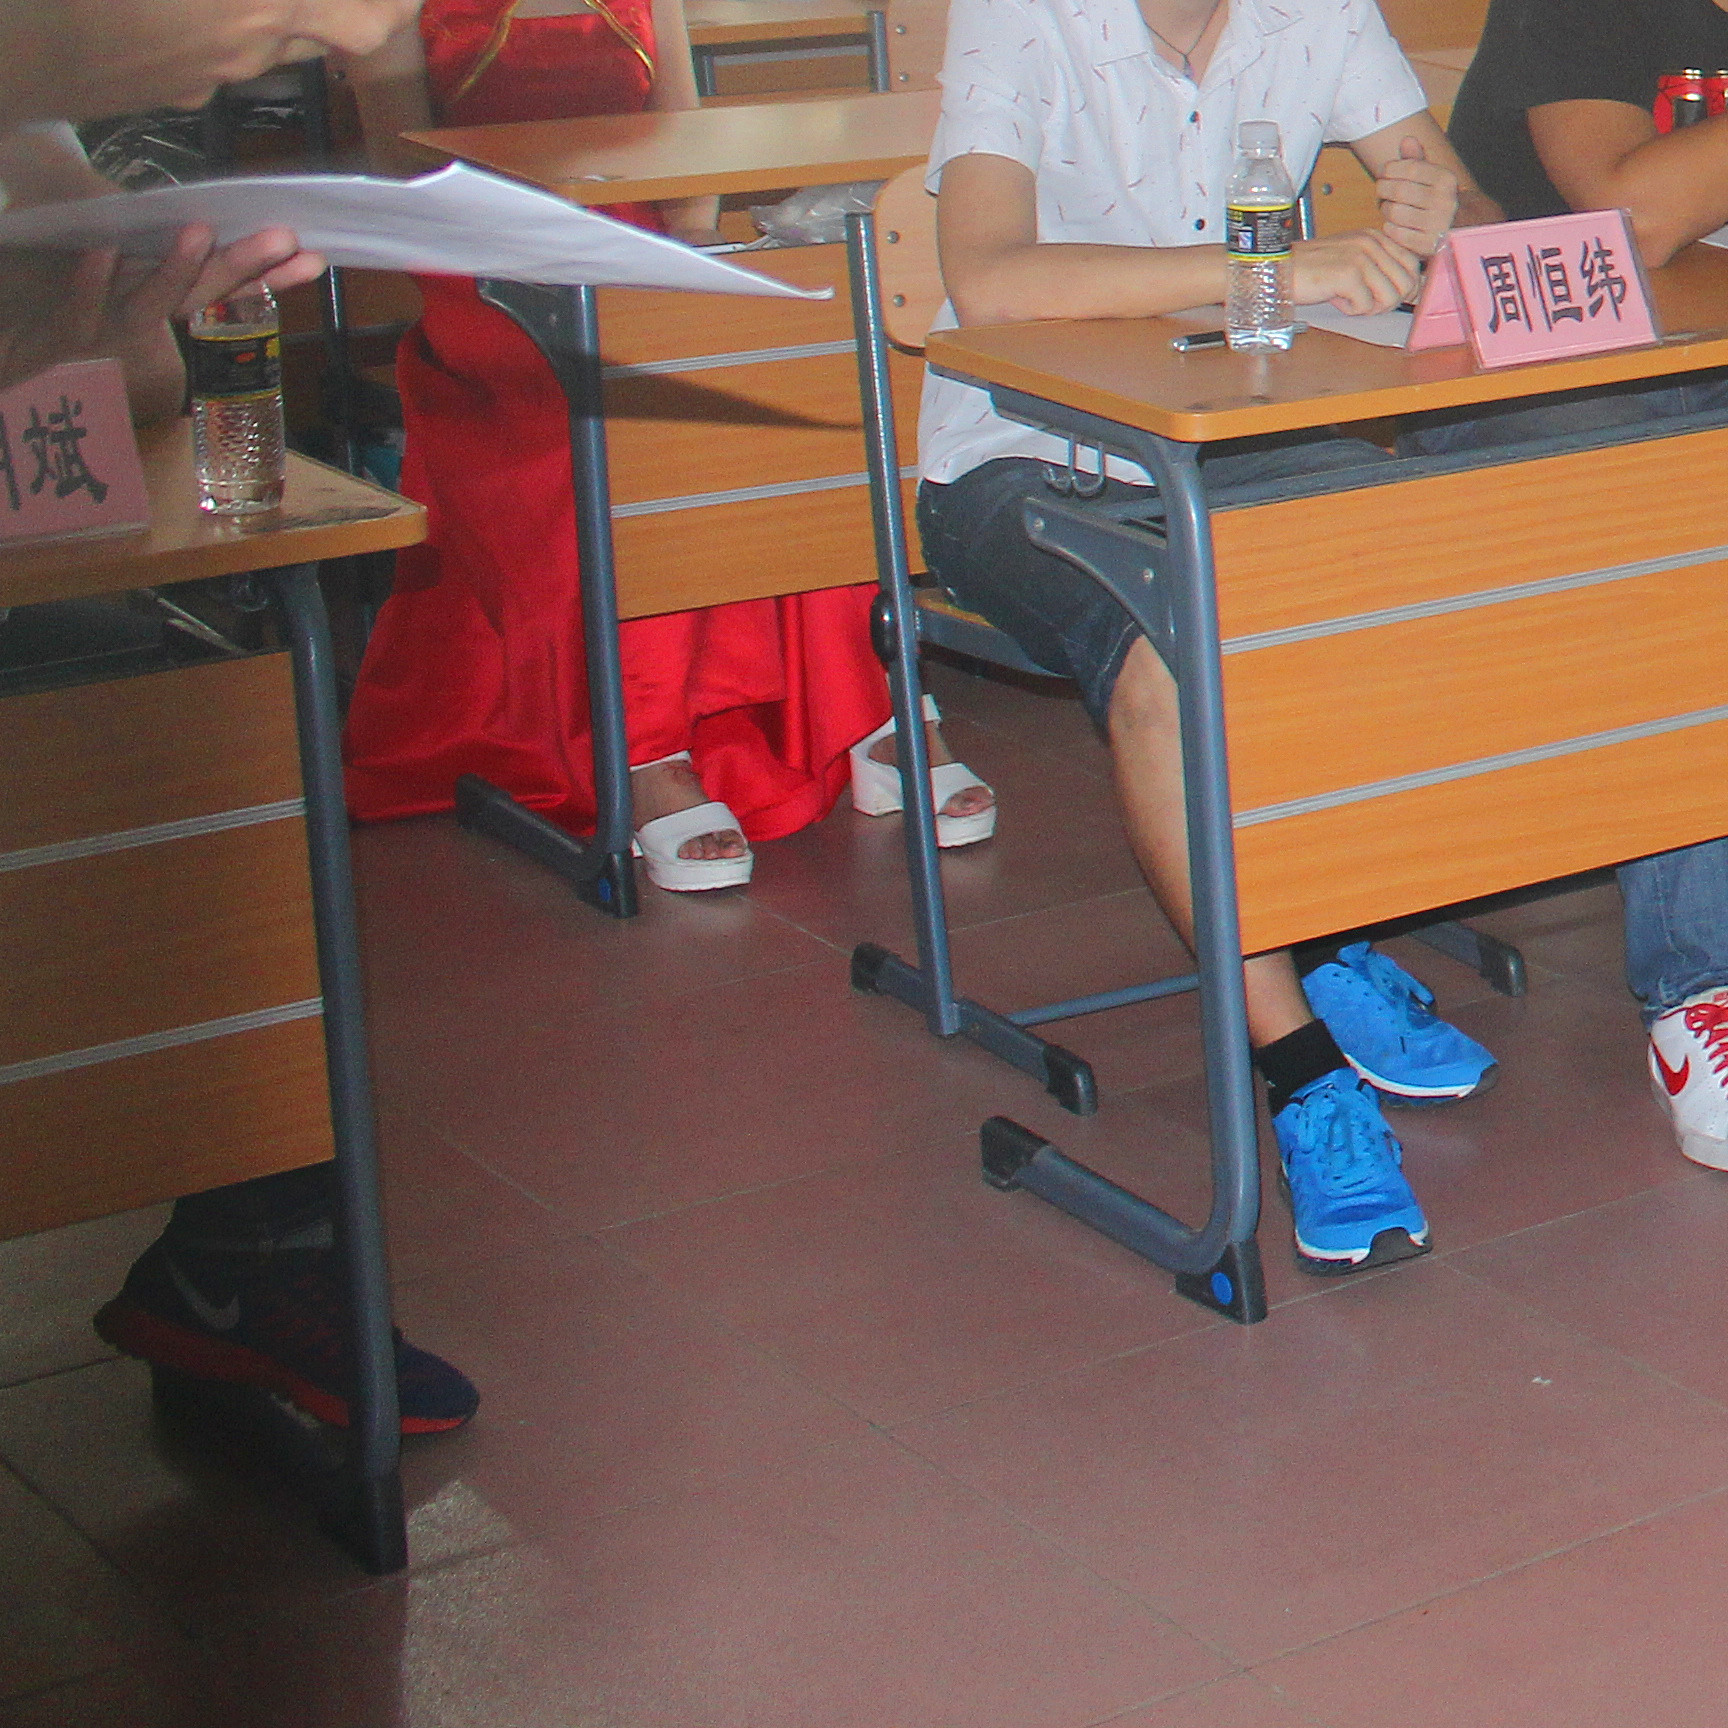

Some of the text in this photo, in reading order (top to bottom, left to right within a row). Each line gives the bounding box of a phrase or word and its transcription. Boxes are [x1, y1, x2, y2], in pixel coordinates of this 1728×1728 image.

[1481, 236, 1626, 333] 周恒纬
[0, 395, 108, 510] 斌
